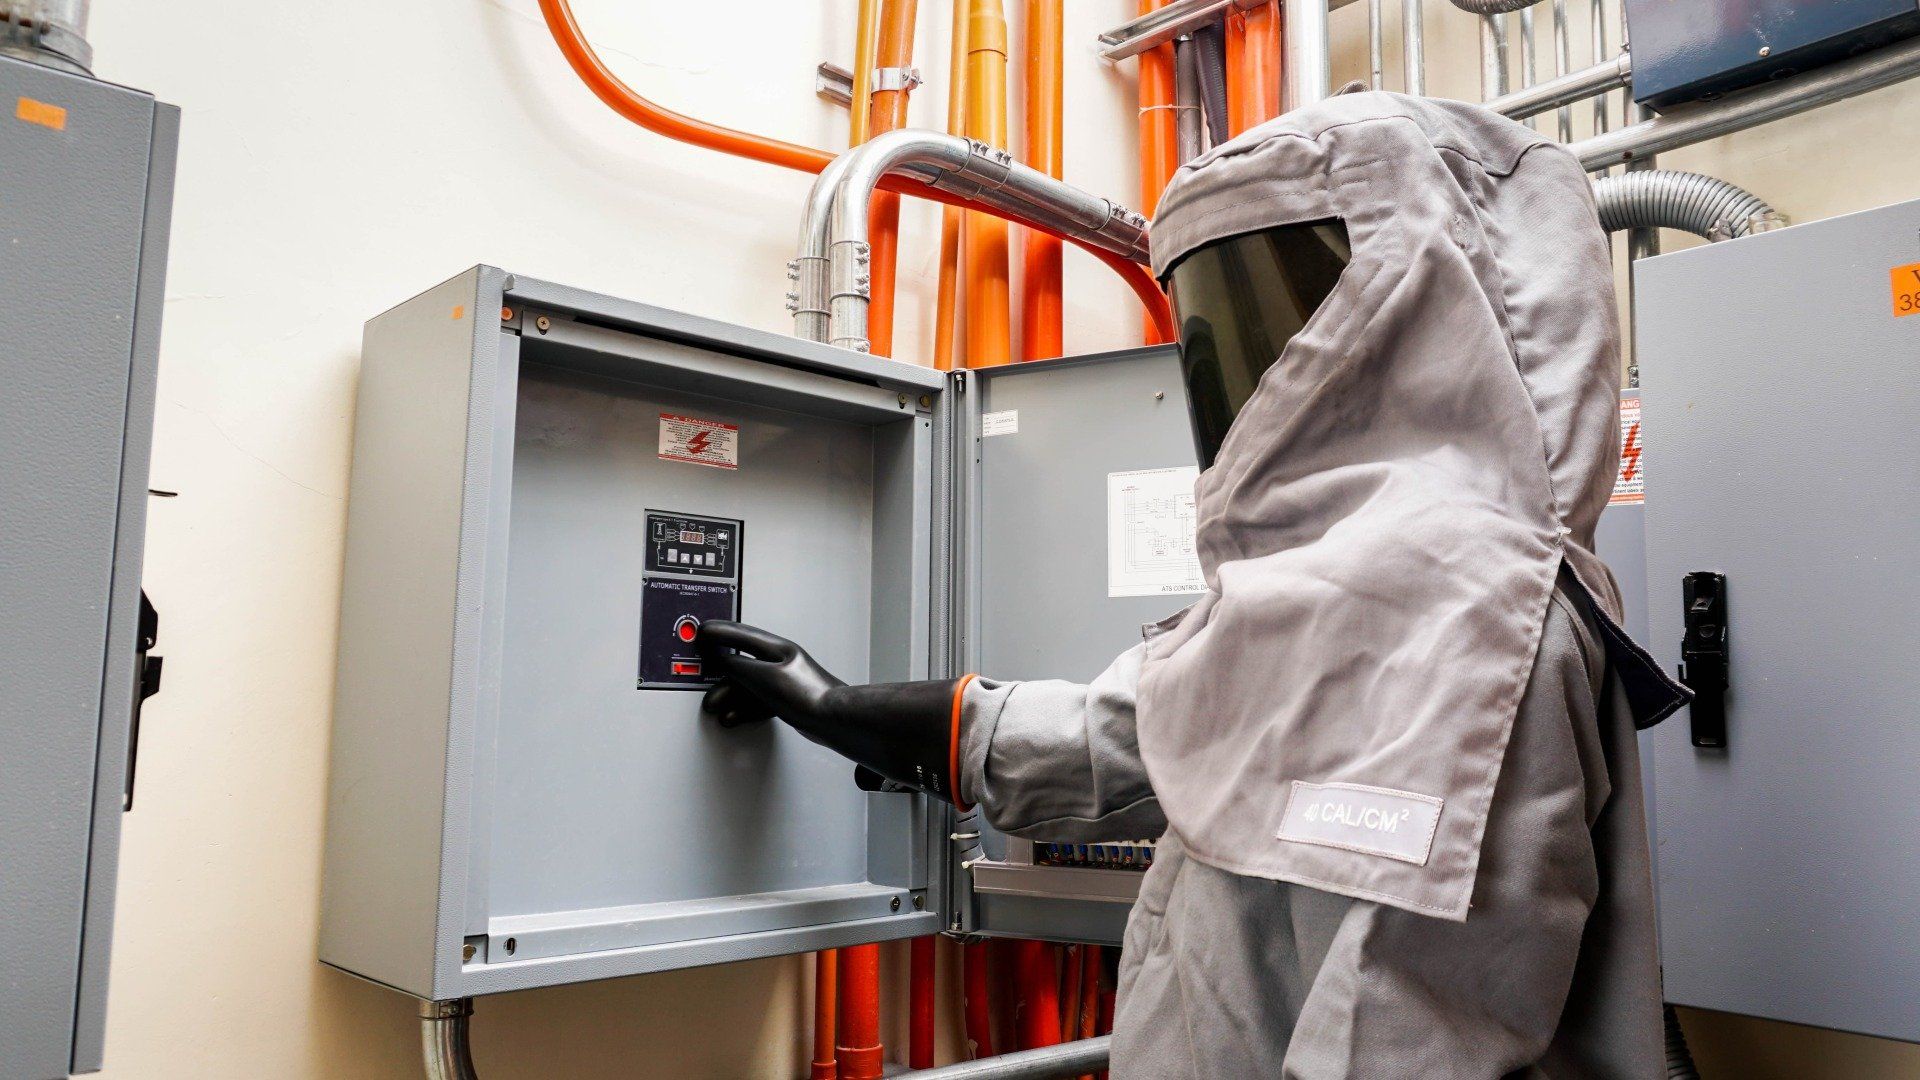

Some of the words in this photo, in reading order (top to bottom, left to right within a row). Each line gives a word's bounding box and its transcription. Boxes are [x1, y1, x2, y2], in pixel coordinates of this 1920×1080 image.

[1620, 400, 1640, 409] ANG
[685, 417, 725, 428] DANGER
[650, 582, 680, 590] AUTOMATIC
[681, 584, 706, 592] TRANSFER
[708, 586, 727, 594] SWITCH
[1173, 584, 1199, 592] CONTROL
[1304, 803, 1320, 822] 40
